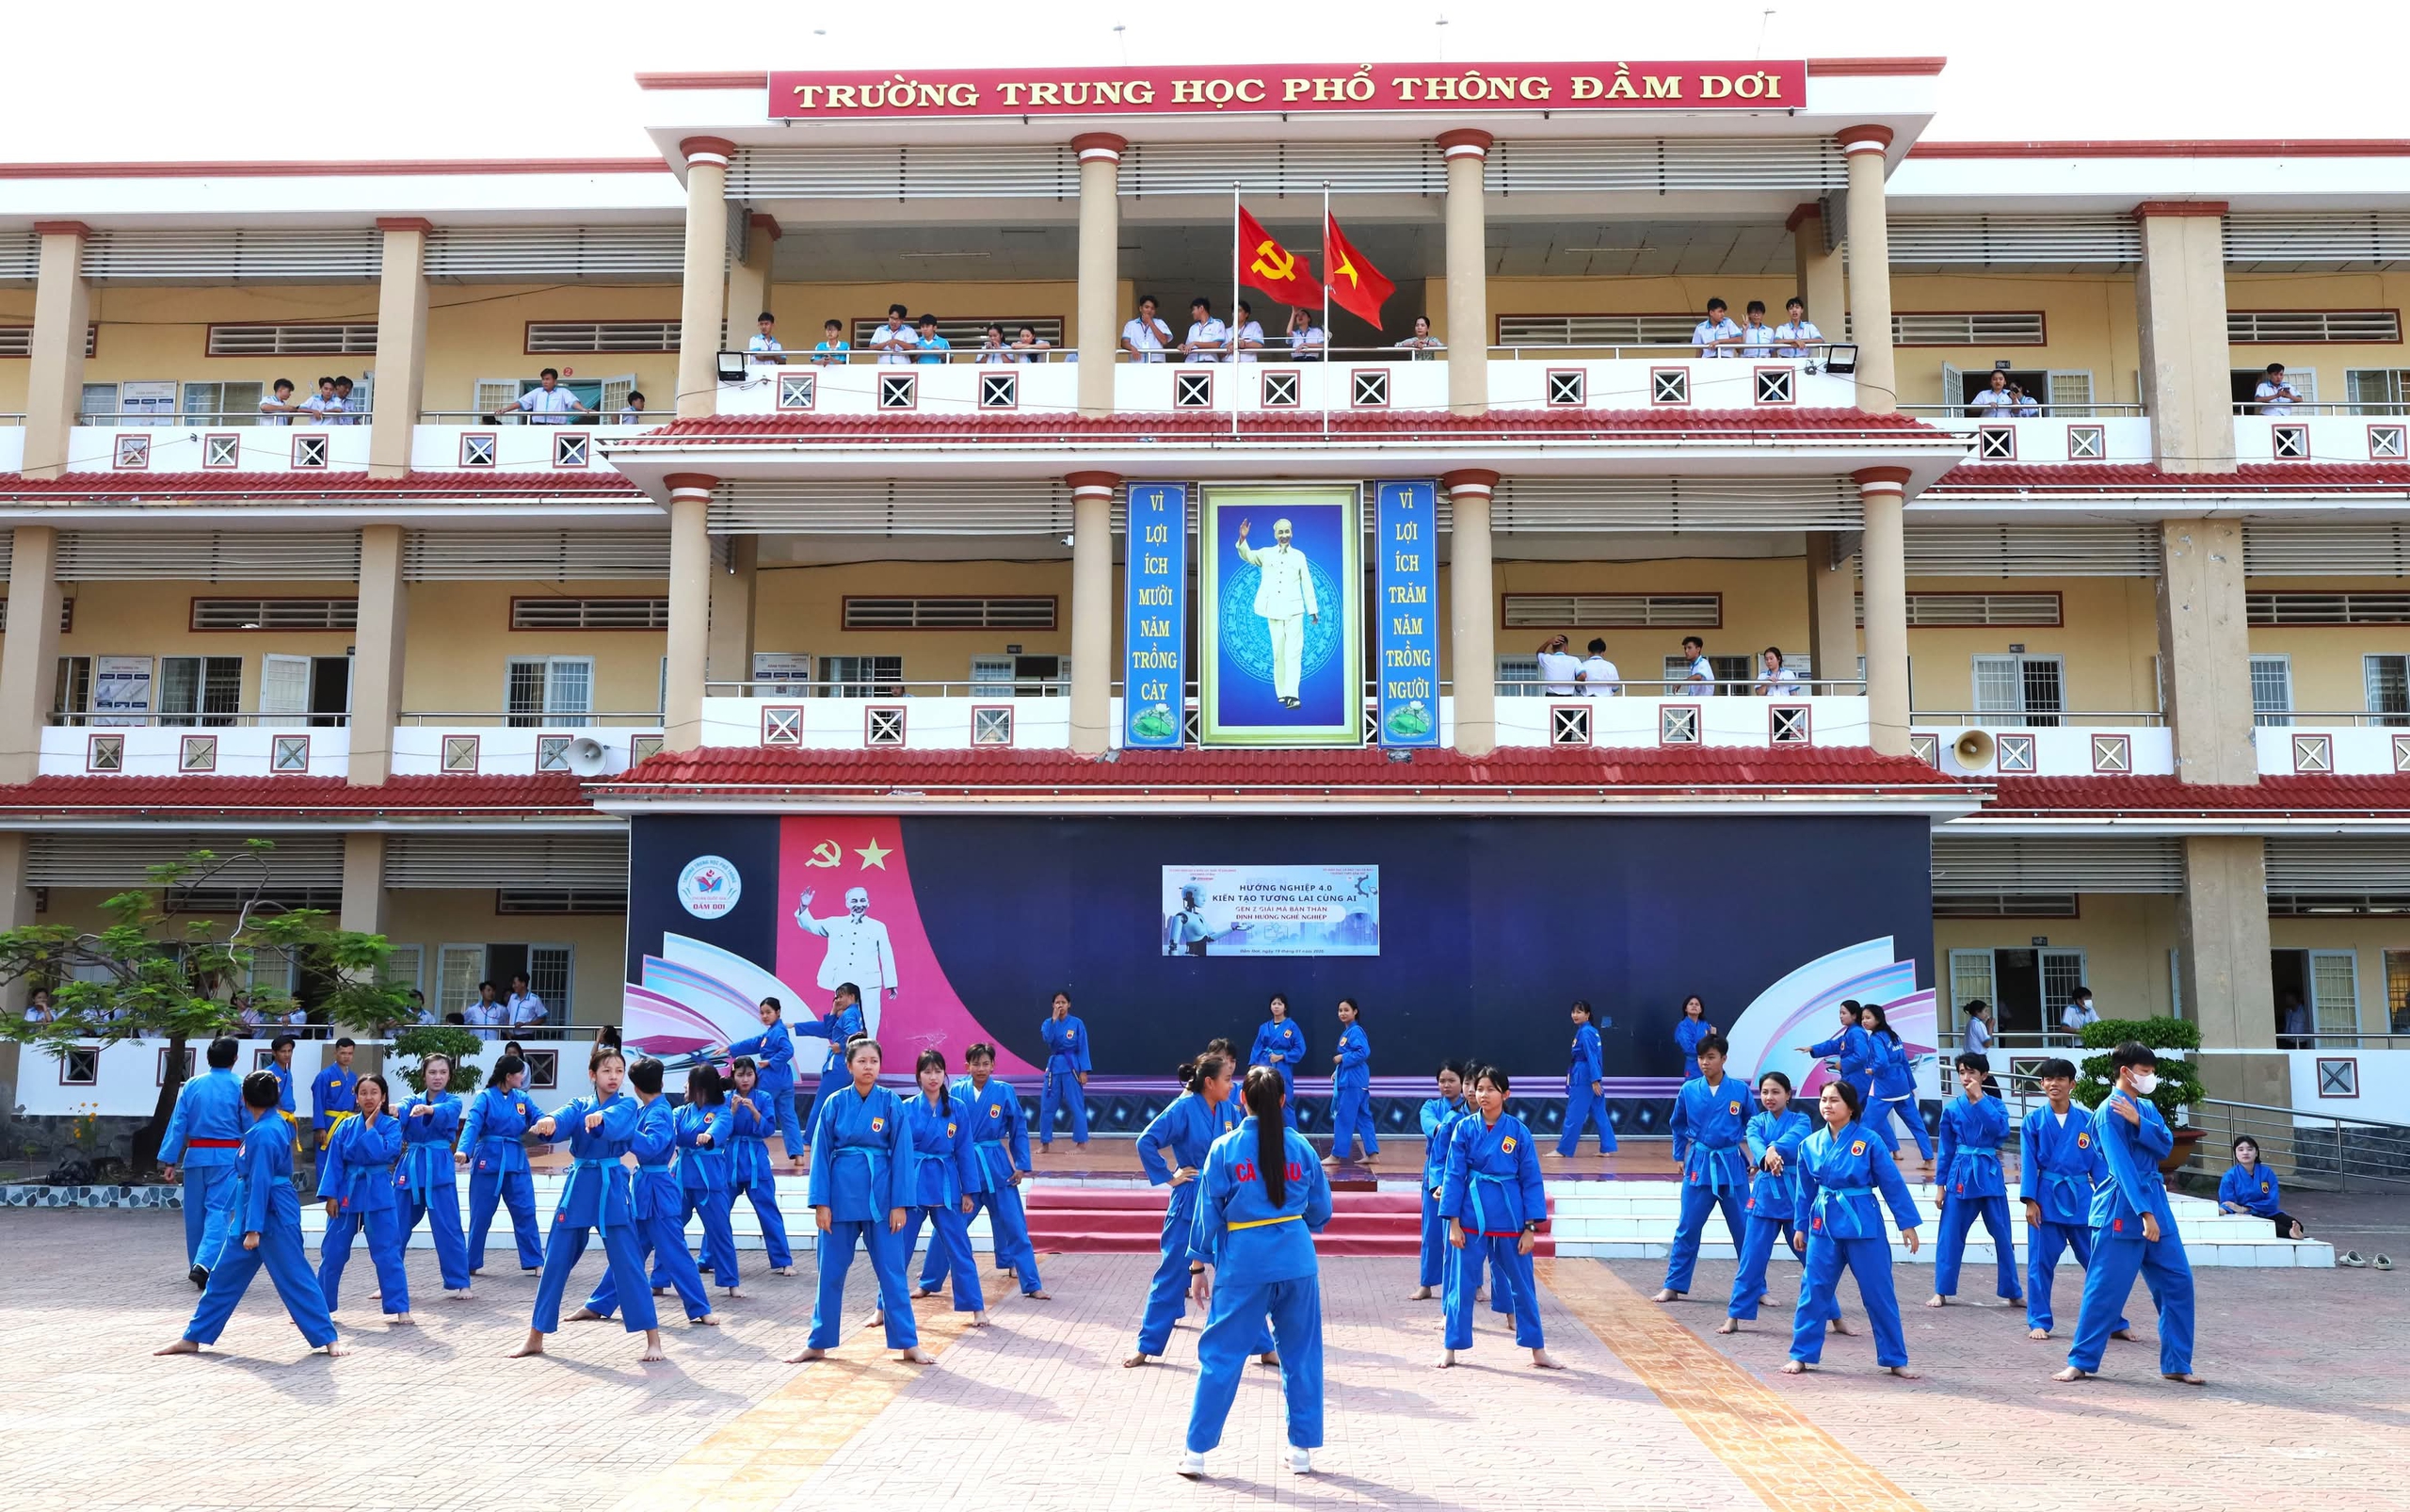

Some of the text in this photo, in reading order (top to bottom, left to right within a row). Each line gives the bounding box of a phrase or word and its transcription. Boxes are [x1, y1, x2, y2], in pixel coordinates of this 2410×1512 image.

[794, 61, 1782, 109] TRƯỜNG TRUNG HỌC PHỔ THÔNG ĐẦM DƠI
[1133, 491, 1178, 701] VÌ LỢI ÍCH MƯỜI NĂM TRỒNG CÂY
[1386, 488, 1432, 700] VÌ LỢI ÍCH TRĂM NĂM TRỒNG NGƯỜI
[1239, 894, 1259, 904] TẠO
[1279, 882, 1316, 893] NGHIỆP
[1235, 1158, 1257, 1182] CÀ
